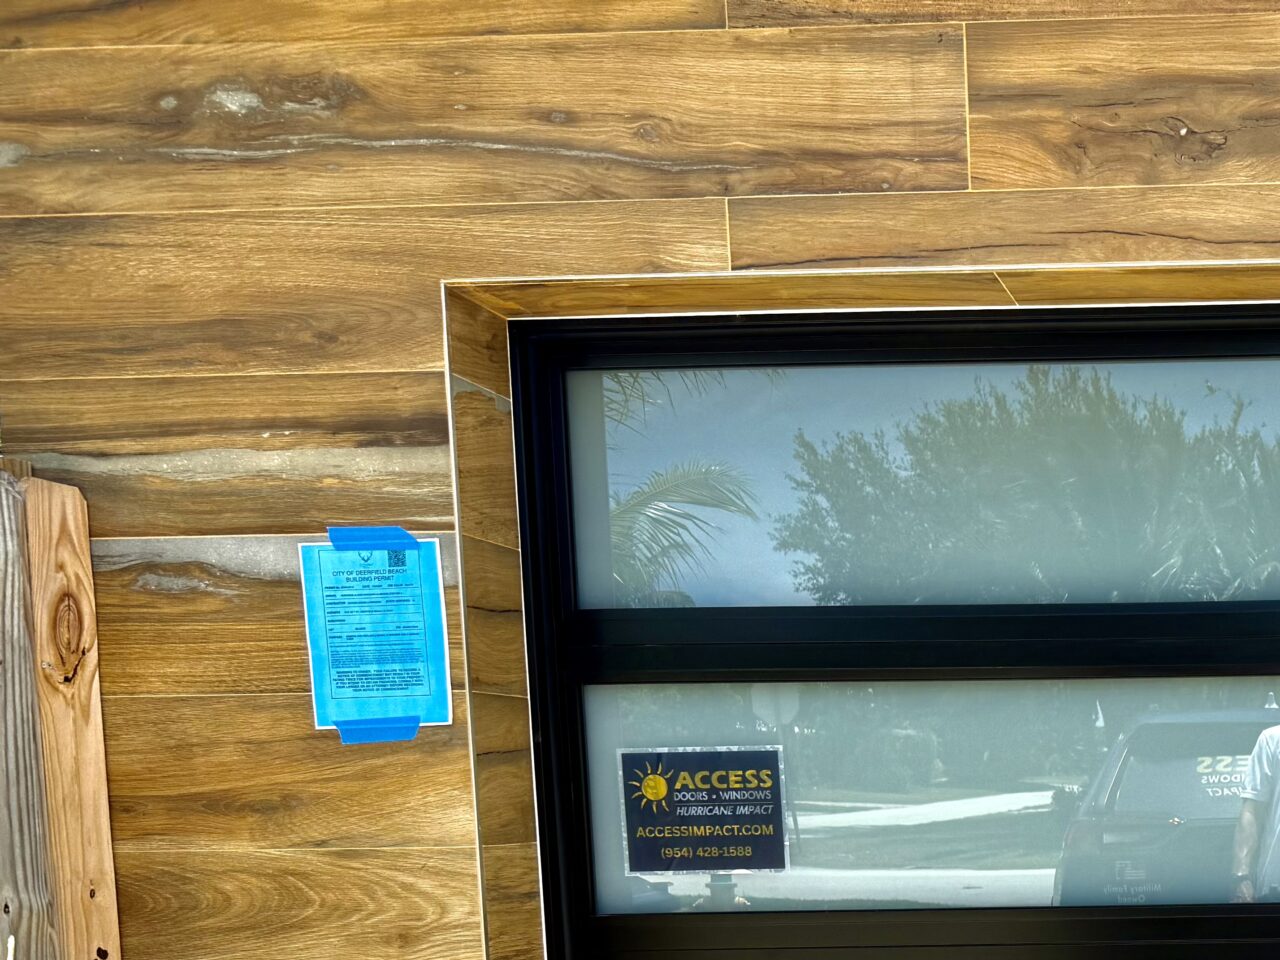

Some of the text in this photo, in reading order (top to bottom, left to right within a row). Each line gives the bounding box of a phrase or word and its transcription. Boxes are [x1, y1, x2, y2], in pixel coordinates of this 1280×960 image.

[674, 770, 774, 790] ACCESS
[674, 790, 772, 801] DOORS WINDOWS
[676, 804, 774, 816] HURRICANE IMPACT
[636, 824, 774, 838] ACCESSIMPACT.COM
[661, 846, 752, 859] (954) 428-1588
